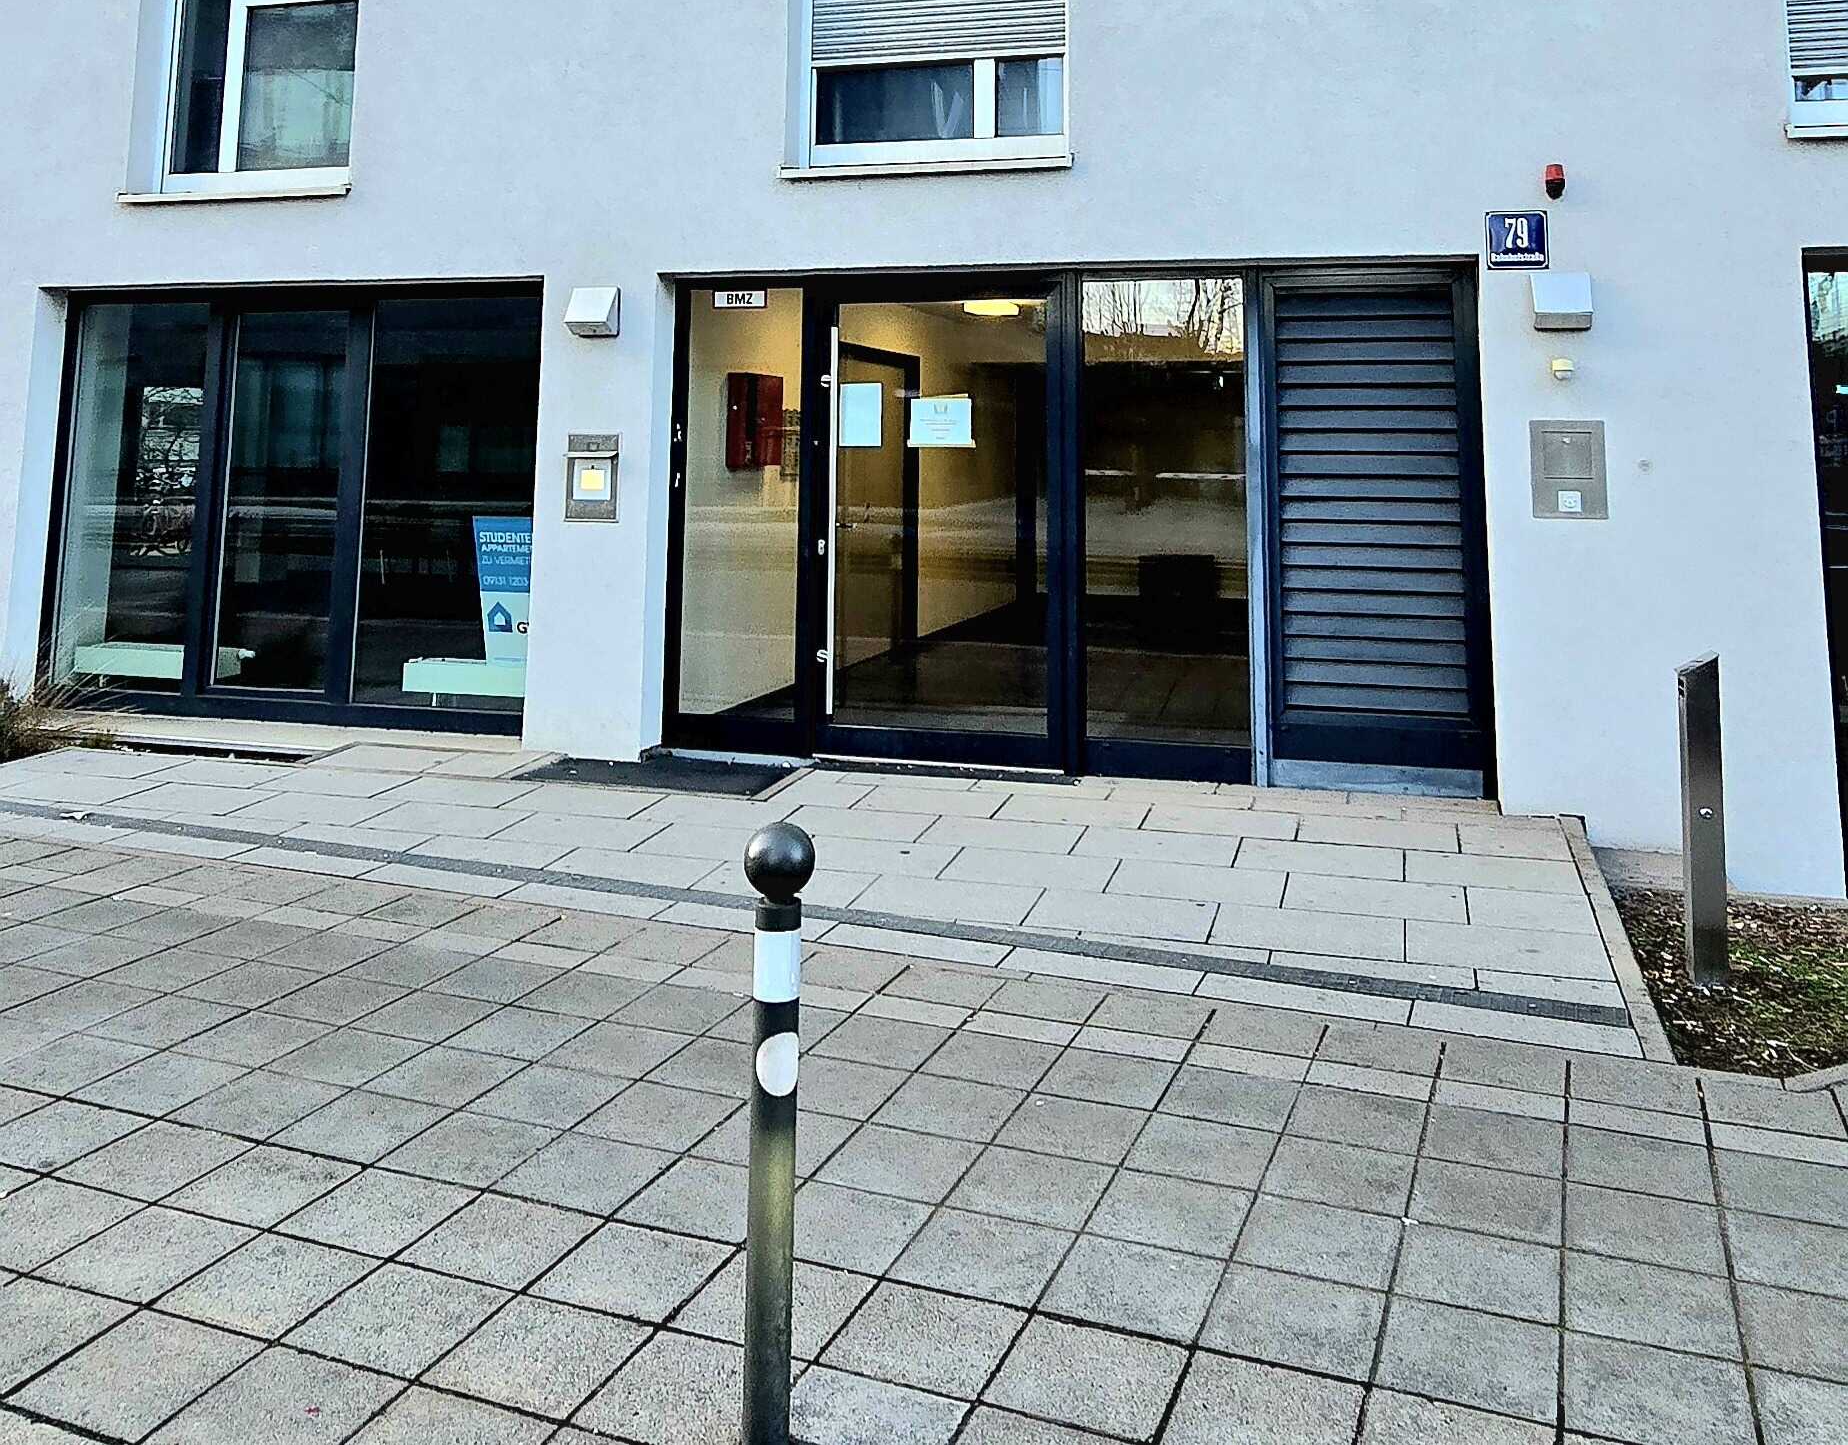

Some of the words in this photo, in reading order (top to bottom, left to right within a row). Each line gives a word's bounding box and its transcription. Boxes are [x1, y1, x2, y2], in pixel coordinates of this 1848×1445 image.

[1504, 217, 1529, 248] 79
[726, 293, 753, 305] BMZ
[479, 531, 532, 543] STUDENTE
[481, 543, 532, 553] APPARTEME
[517, 621, 530, 634] G
